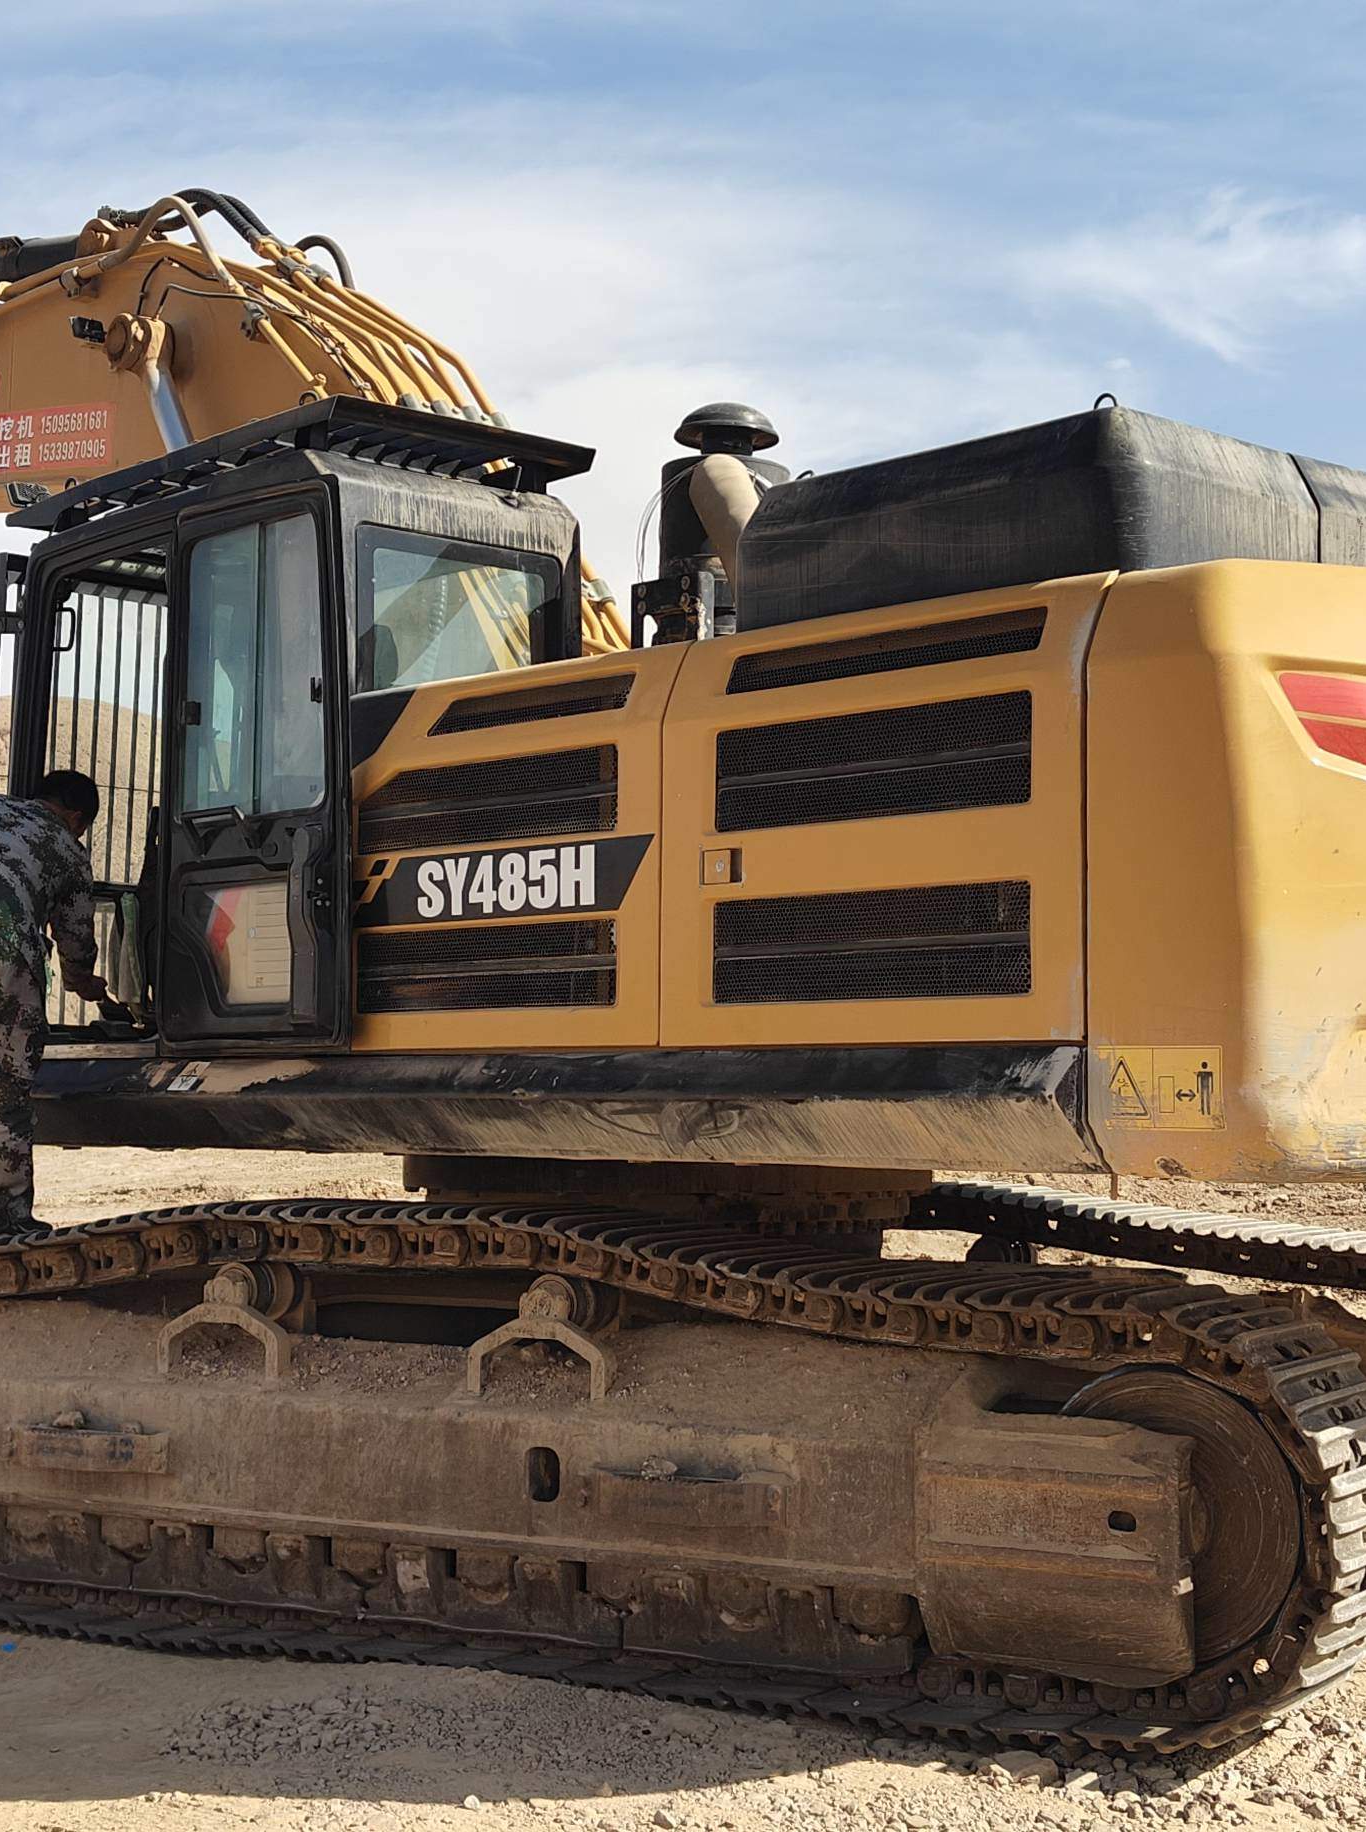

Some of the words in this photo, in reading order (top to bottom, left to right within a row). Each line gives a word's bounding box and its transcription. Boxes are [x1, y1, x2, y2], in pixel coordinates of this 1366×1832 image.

[40, 410, 108, 435] 15095681681
[38, 439, 106, 462] 15339870905
[417, 844, 595, 918] SY485H
